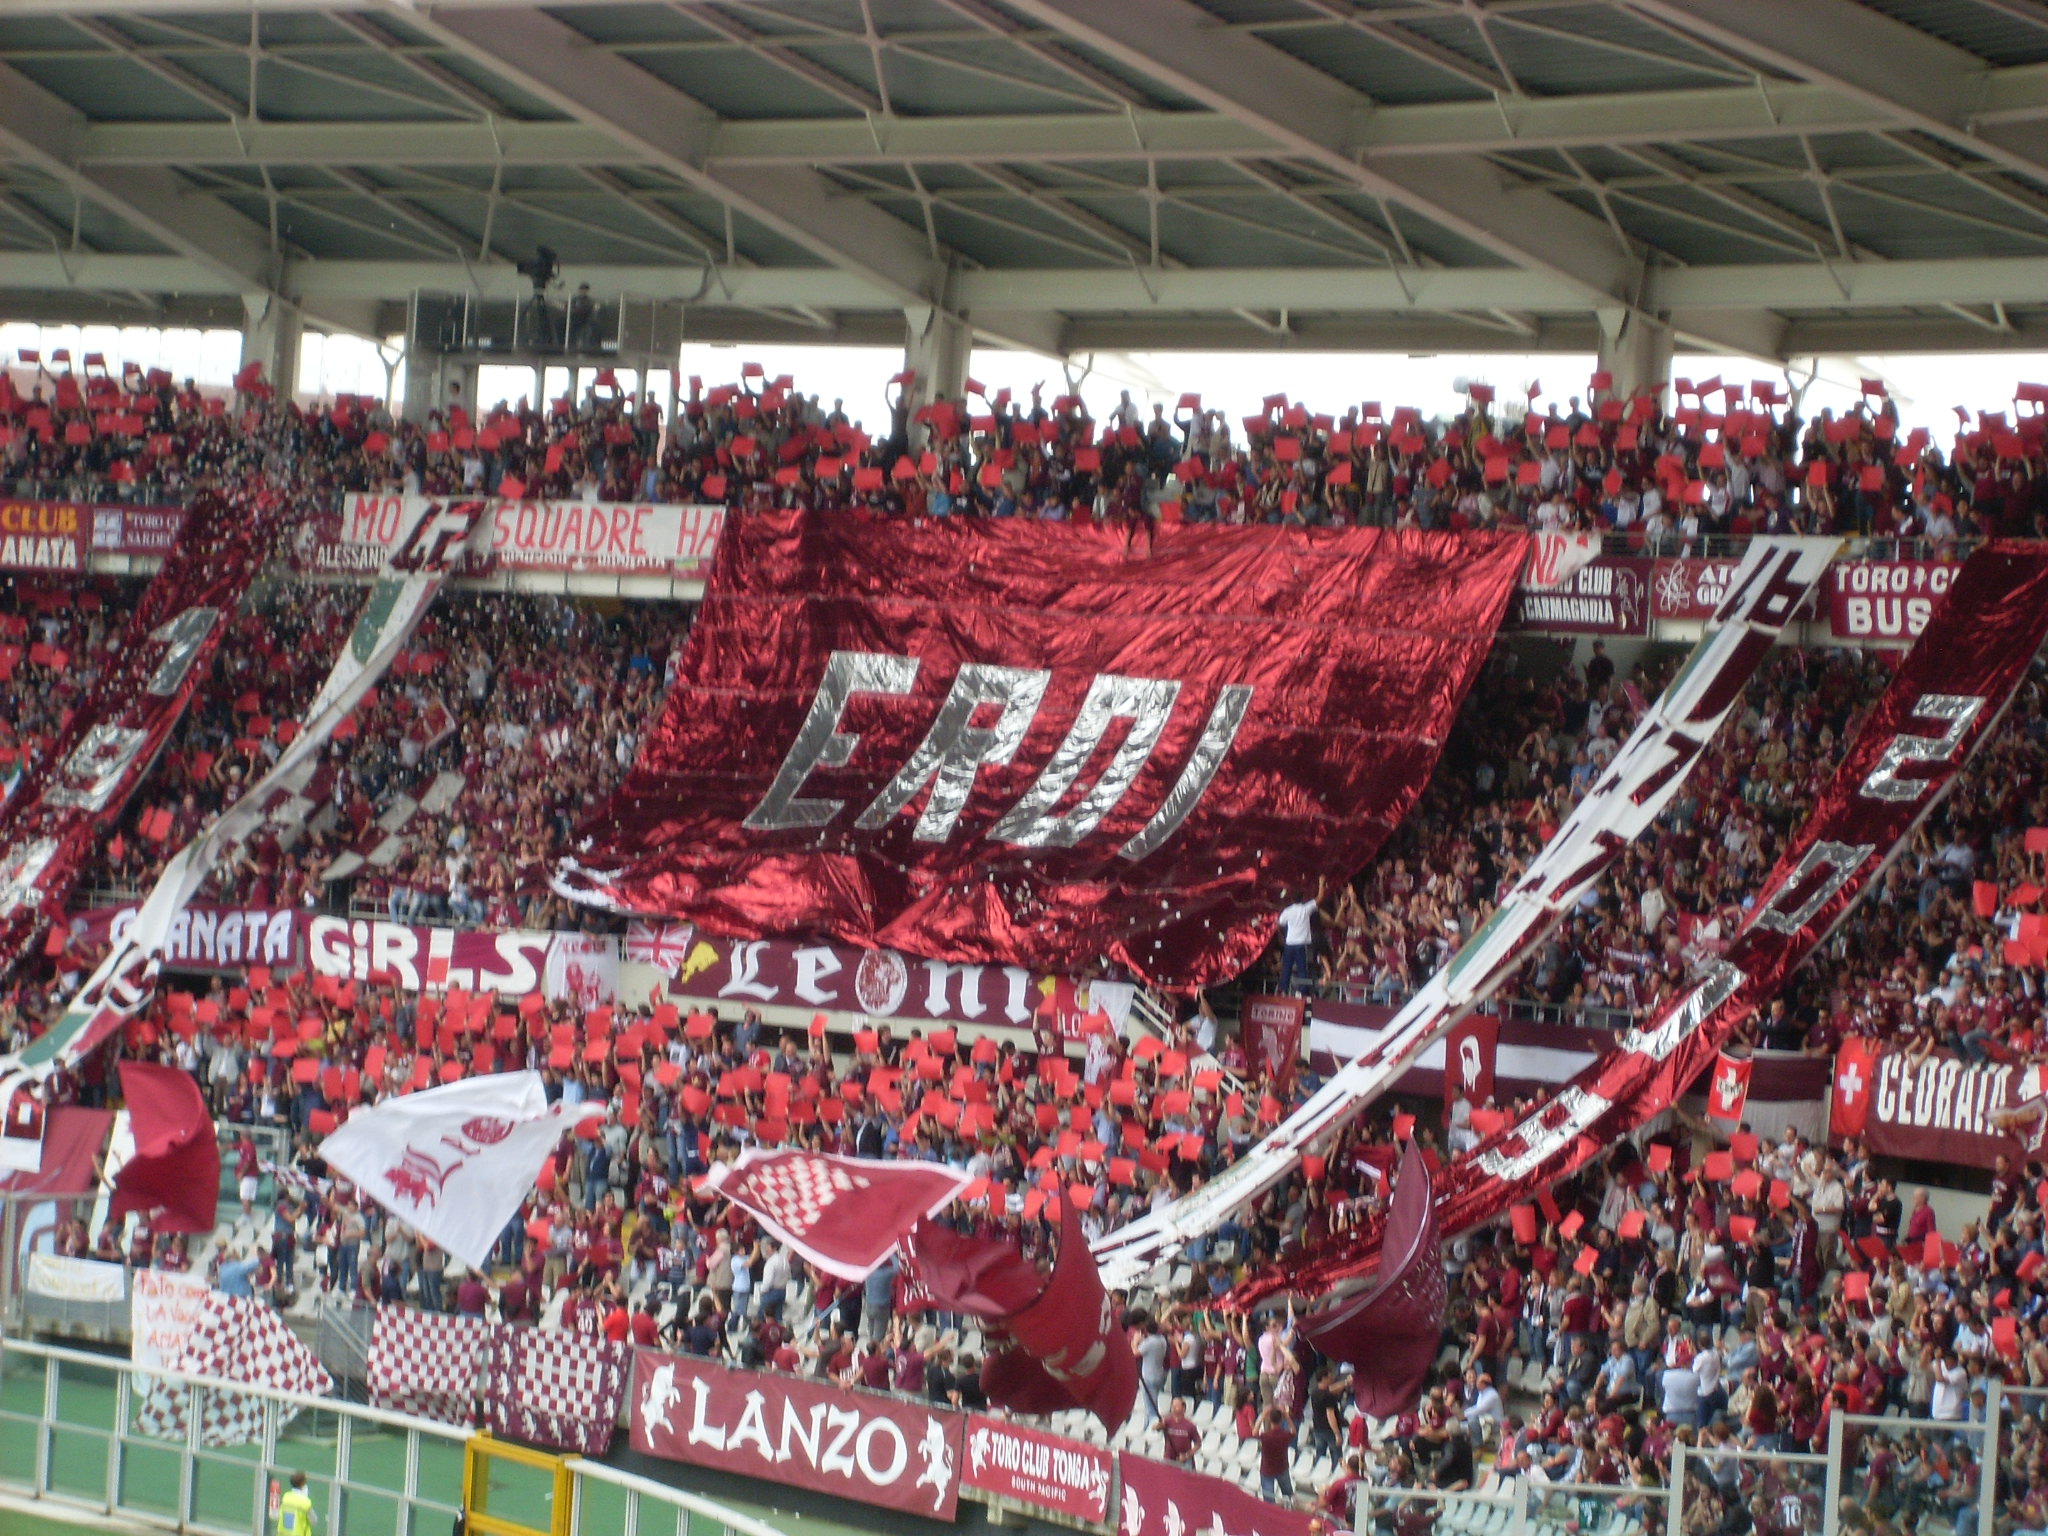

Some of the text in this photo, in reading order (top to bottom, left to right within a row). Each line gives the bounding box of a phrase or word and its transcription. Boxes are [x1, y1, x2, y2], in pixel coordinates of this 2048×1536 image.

[2, 505, 78, 533] CLUB
[492, 504, 653, 557] SQUADRE
[0, 535, 77, 569] ANATA
[1579, 566, 1613, 597] CLUB
[1836, 565, 1909, 592] TORO
[109, 907, 292, 966] GANATA
[688, 1375, 908, 1486] LANZO
[991, 1430, 1020, 1472] TORO
[1022, 1440, 1050, 1480] CLUB
[1011, 1475, 1067, 1503] SOUTH PACIFIC
[1782, 1503, 1802, 1528] 10
